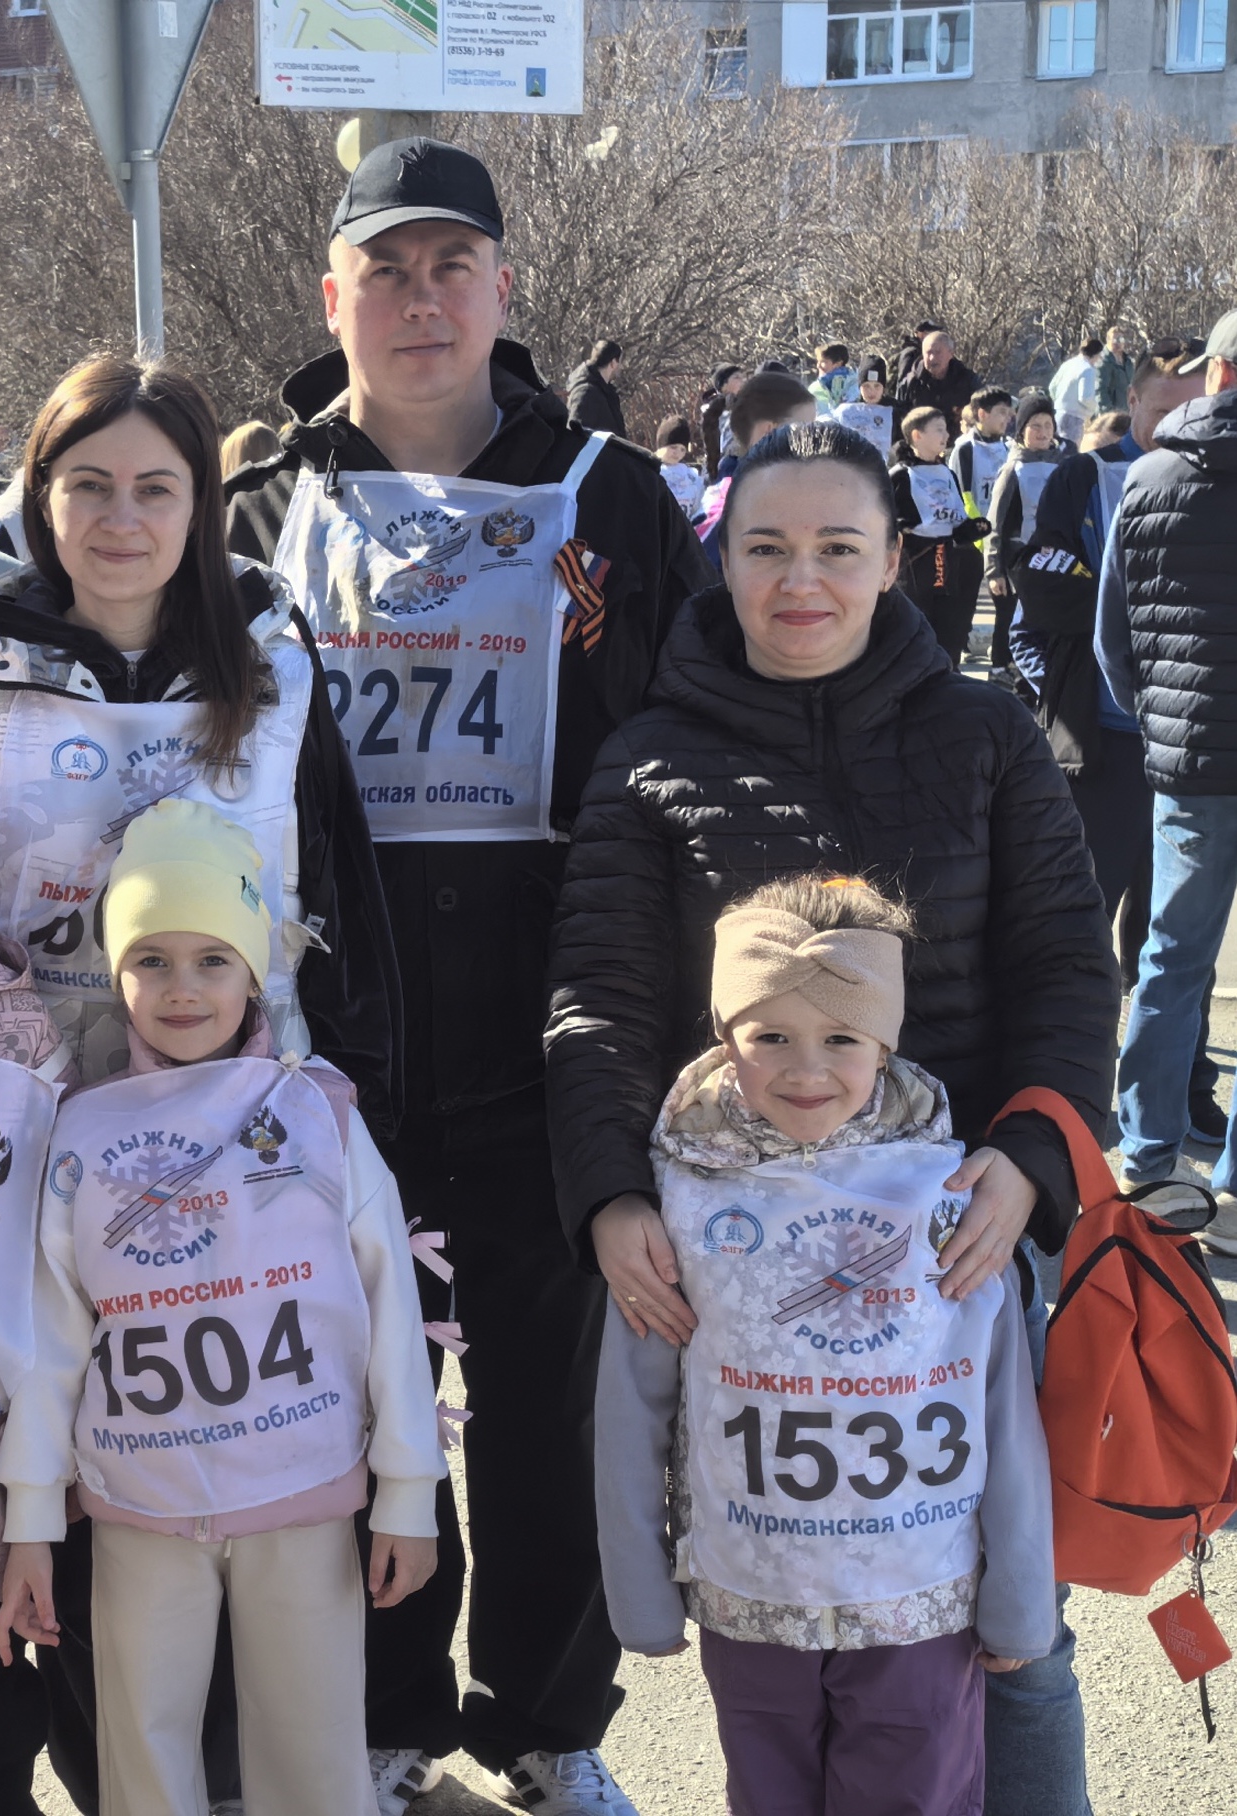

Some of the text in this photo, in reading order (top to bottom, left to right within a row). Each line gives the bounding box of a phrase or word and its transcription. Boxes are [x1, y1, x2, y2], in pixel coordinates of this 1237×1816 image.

[386, 510, 465, 537] ЛЫЖНЯ
[425, 572, 467, 588] 2019
[375, 594, 450, 615] ОССИИ
[312, 632, 371, 649] ЖНЯ
[376, 632, 460, 650] РОССИИ
[479, 634, 527, 654] 2019
[125, 737, 201, 768] ЛЫЖН
[426, 781, 515, 806] область
[39, 881, 94, 903] ЛЫЖ
[101, 1130, 204, 1167] ЛЫЖНЯ
[177, 1190, 230, 1214] 2013
[785, 1206, 896, 1240] ЛЫЖНЯ
[123, 1227, 218, 1267] РОССИИ
[96, 1289, 144, 1317] ЖНЯ
[149, 1276, 244, 1310] РОССИИ
[265, 1262, 313, 1290] 2013
[862, 1287, 916, 1305] 2013
[795, 1322, 901, 1355] РОССИИ
[92, 1299, 314, 1418] 1504
[720, 1364, 814, 1396] ЛЫЖНЯ
[822, 1373, 917, 1397] РОССИИ
[928, 1357, 975, 1388] 2013
[92, 1389, 341, 1455] Мурманская область
[723, 1401, 972, 1501] 1533
[727, 1490, 983, 1537] Мурманская область
